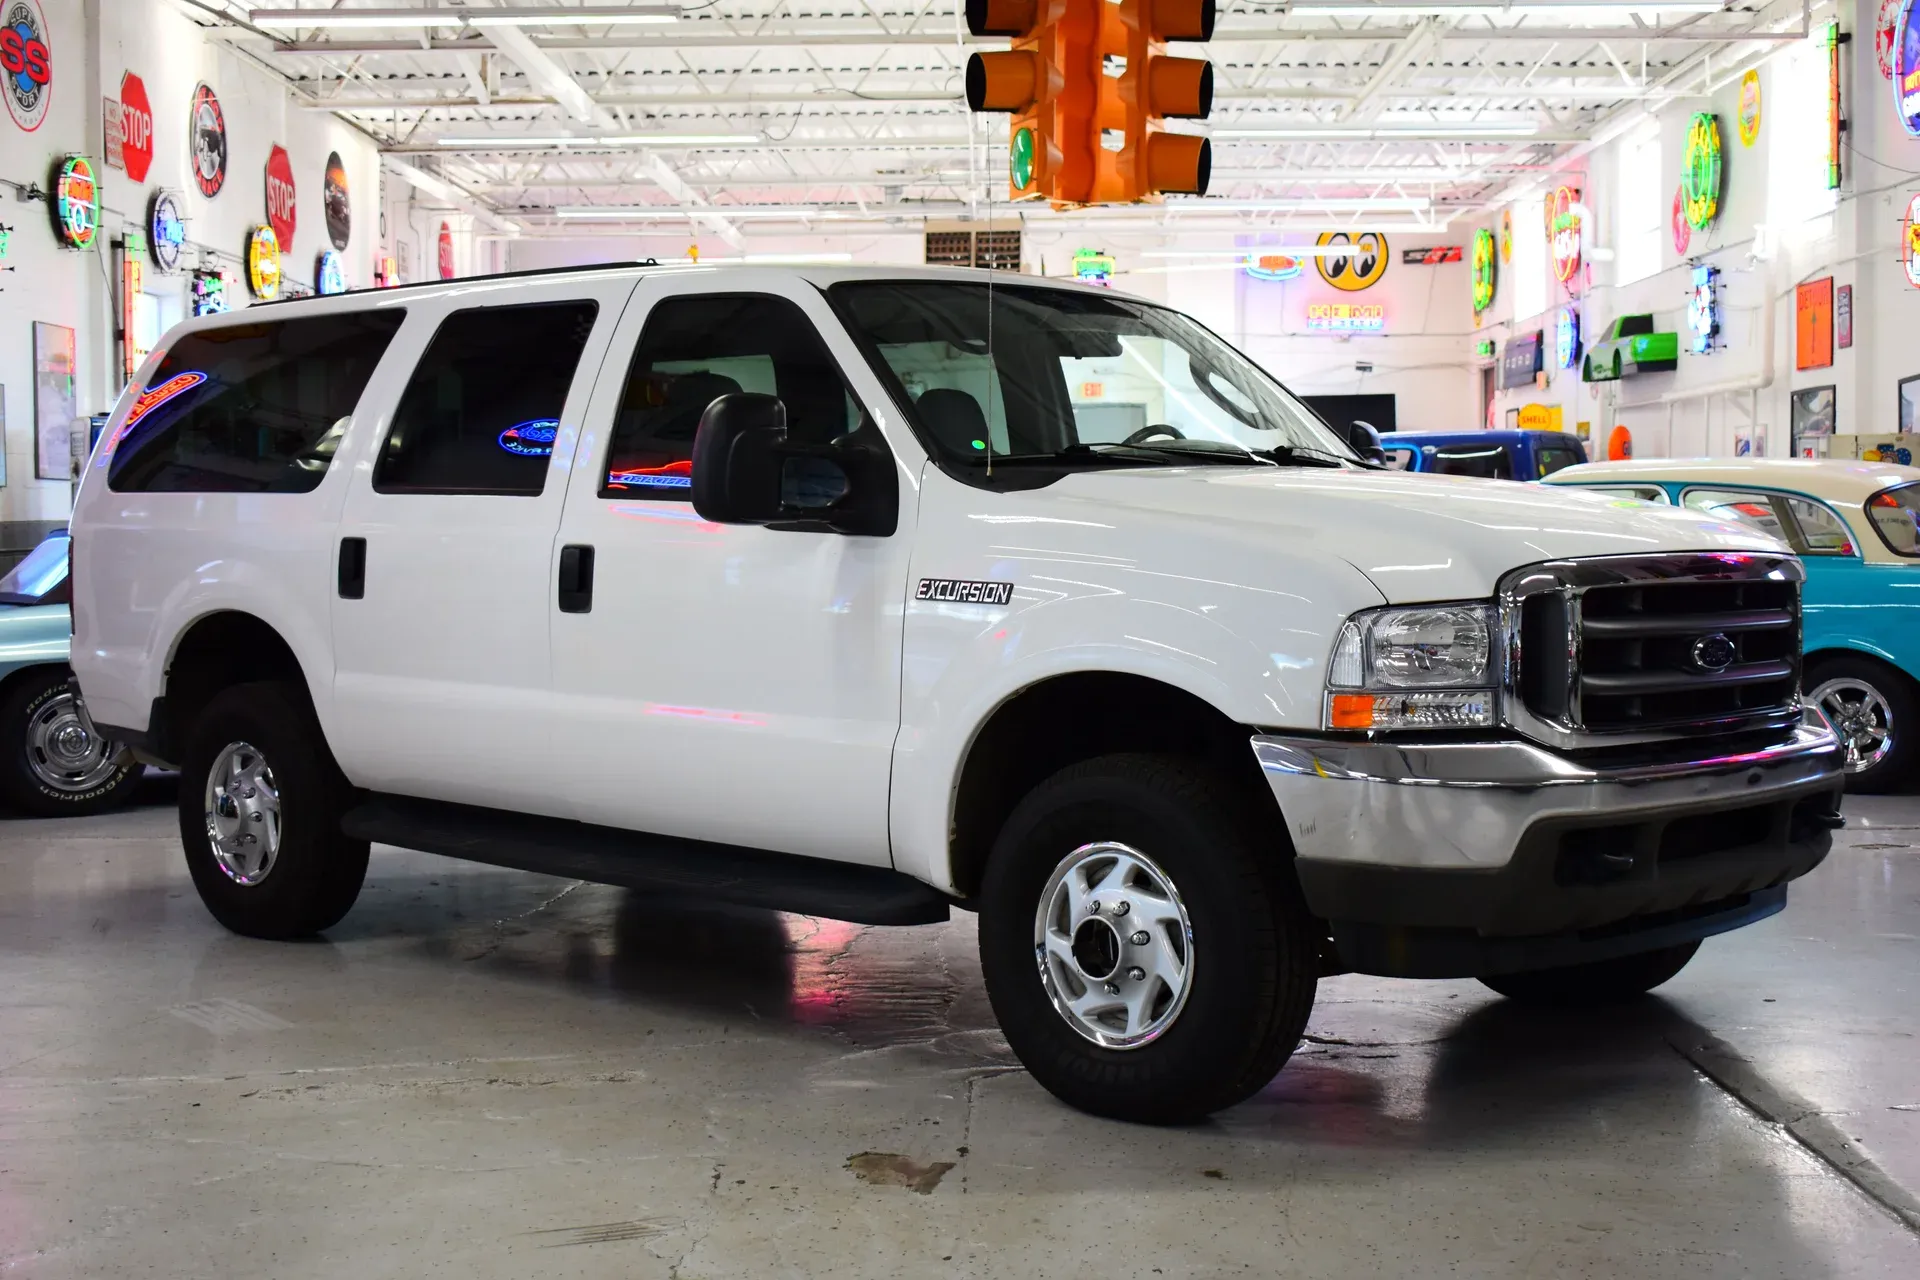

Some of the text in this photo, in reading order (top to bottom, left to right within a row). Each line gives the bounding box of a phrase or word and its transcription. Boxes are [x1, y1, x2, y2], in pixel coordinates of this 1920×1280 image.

[0, 26, 49, 85] SS
[120, 103, 151, 151] STOP
[268, 175, 296, 223] STOP
[1309, 303, 1384, 319] HEMI
[1521, 415, 1547, 425] SHELL
[916, 580, 1011, 604] EXCURSION
[26, 684, 69, 714] Radia
[40, 766, 130, 801] BFGoodrich
